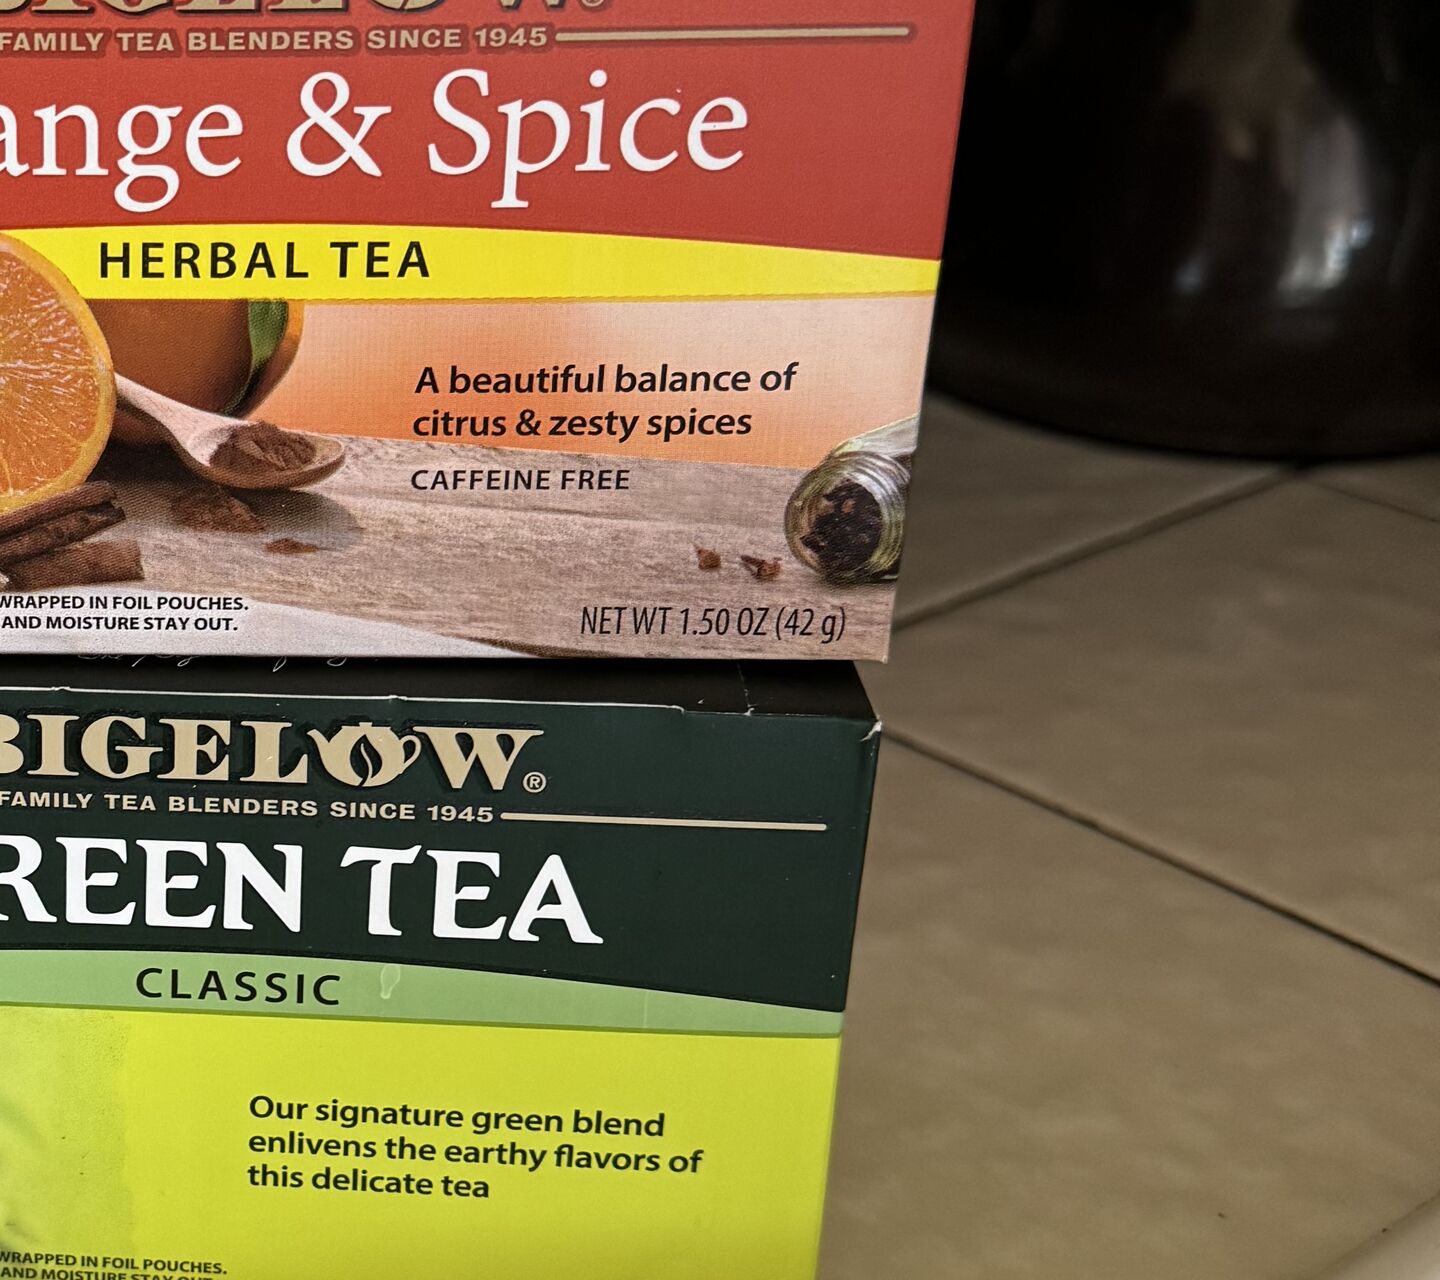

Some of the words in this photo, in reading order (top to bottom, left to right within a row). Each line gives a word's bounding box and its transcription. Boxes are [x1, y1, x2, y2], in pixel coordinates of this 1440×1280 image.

[117, 31, 176, 55] TEA
[187, 29, 356, 56] BLENDERS
[366, 27, 462, 53] SINCE
[475, 26, 549, 52] 1945
[286, 71, 393, 178] &
[427, 68, 749, 210] Spice
[100, 241, 309, 282] HERBAL
[328, 240, 433, 280] TEA
[414, 365, 440, 394] A
[449, 362, 608, 395] beautiful
[615, 362, 752, 394] balance
[759, 360, 799, 392] of
[412, 408, 508, 437] citrus
[515, 410, 543, 437] &
[548, 409, 641, 443] zesty
[646, 408, 754, 443] spices
[410, 467, 552, 492] CAFFEINE
[559, 467, 631, 491] FREE
[89, 595, 108, 610] IN
[112, 595, 154, 611] FOIL
[157, 596, 249, 612] POUCHES.
[0, 615, 42, 630] AND
[45, 615, 141, 631] MOISTURE
[143, 616, 194, 631] STAY
[196, 616, 239, 632] OUT.
[580, 606, 627, 636] NET
[630, 606, 675, 636] WT
[679, 606, 733, 637] 1.50
[736, 606, 770, 637] OZ
[774, 605, 817, 642] (42
[821, 606, 847, 643] g)
[104, 793, 157, 813] TEA
[169, 795, 321, 818] BLENDERS
[330, 800, 417, 821] SINCE
[427, 804, 495, 824] 1945
[340, 844, 605, 945] TEA
[135, 966, 342, 1007] CLASSIC
[248, 1095, 309, 1120] Our
[315, 1098, 464, 1129] signature
[471, 1109, 565, 1135] green
[572, 1109, 666, 1138] blend
[248, 1131, 378, 1159] enlivens
[385, 1136, 437, 1162] the
[444, 1141, 548, 1173] earthy
[554, 1143, 661, 1173] flavors
[668, 1148, 705, 1174] of
[247, 1163, 305, 1189] this
[311, 1166, 435, 1196] delicate
[441, 1174, 491, 1199] tea
[0, 1266, 38, 1280] AND
[81, 1254, 98, 1268] IN
[102, 1256, 140, 1270] FOIL
[143, 1259, 228, 1276] POUCHES.
